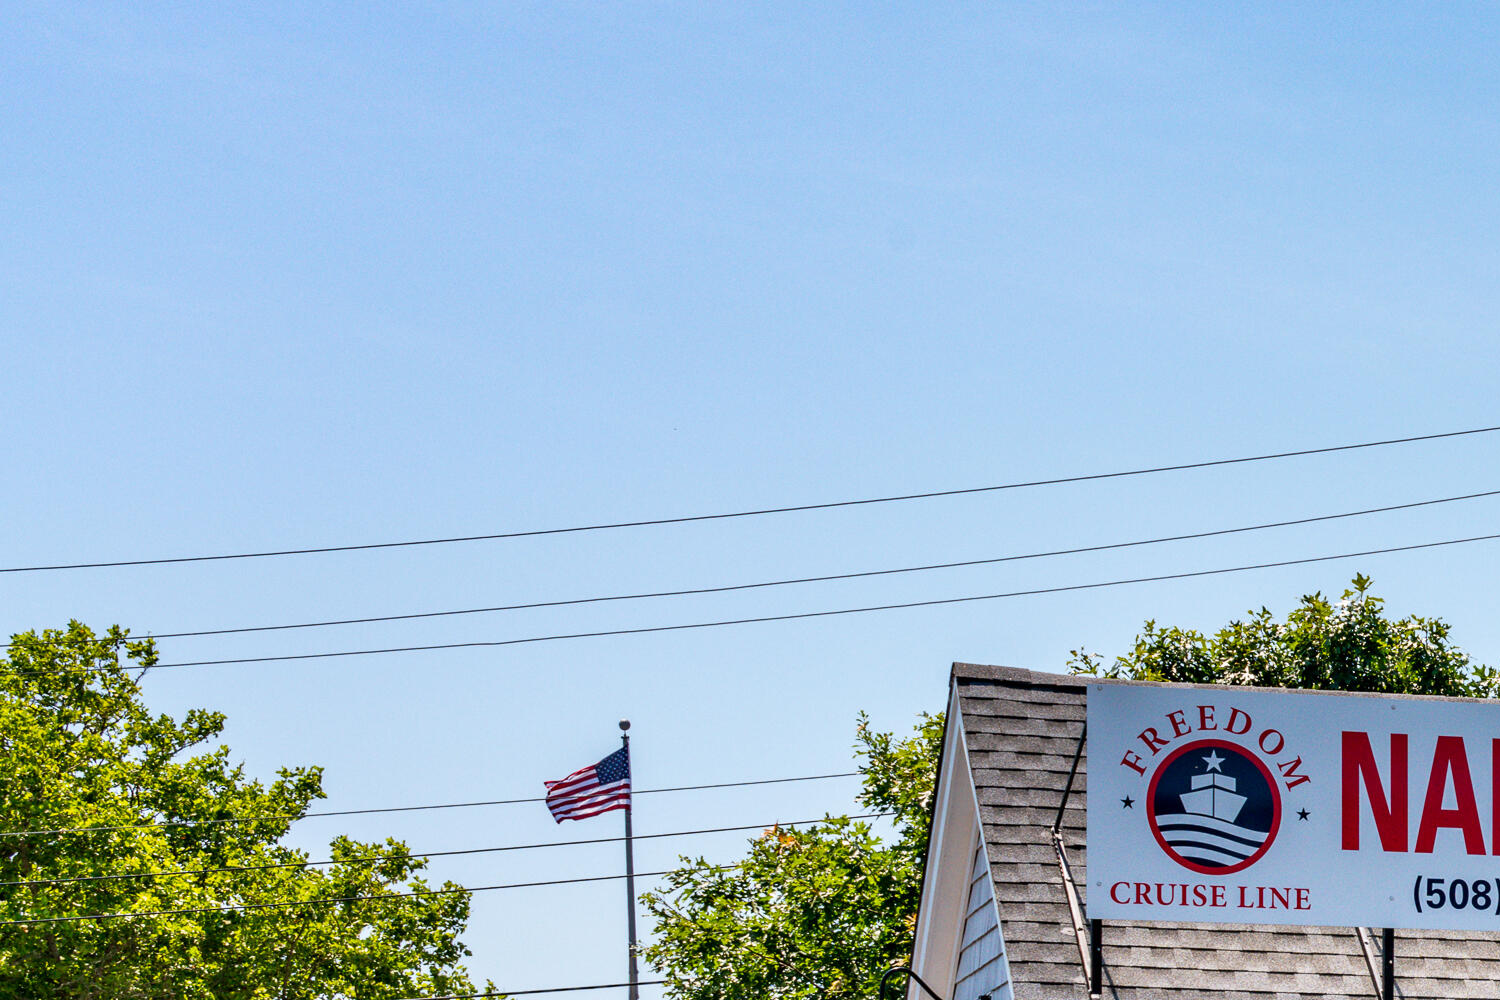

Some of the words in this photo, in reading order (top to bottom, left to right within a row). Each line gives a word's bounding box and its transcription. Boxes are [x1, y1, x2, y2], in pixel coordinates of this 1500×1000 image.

[1120, 705, 1312, 792] FREEDOM
[1110, 881, 1227, 908] CRUISE
[1237, 886, 1312, 910] LINE
